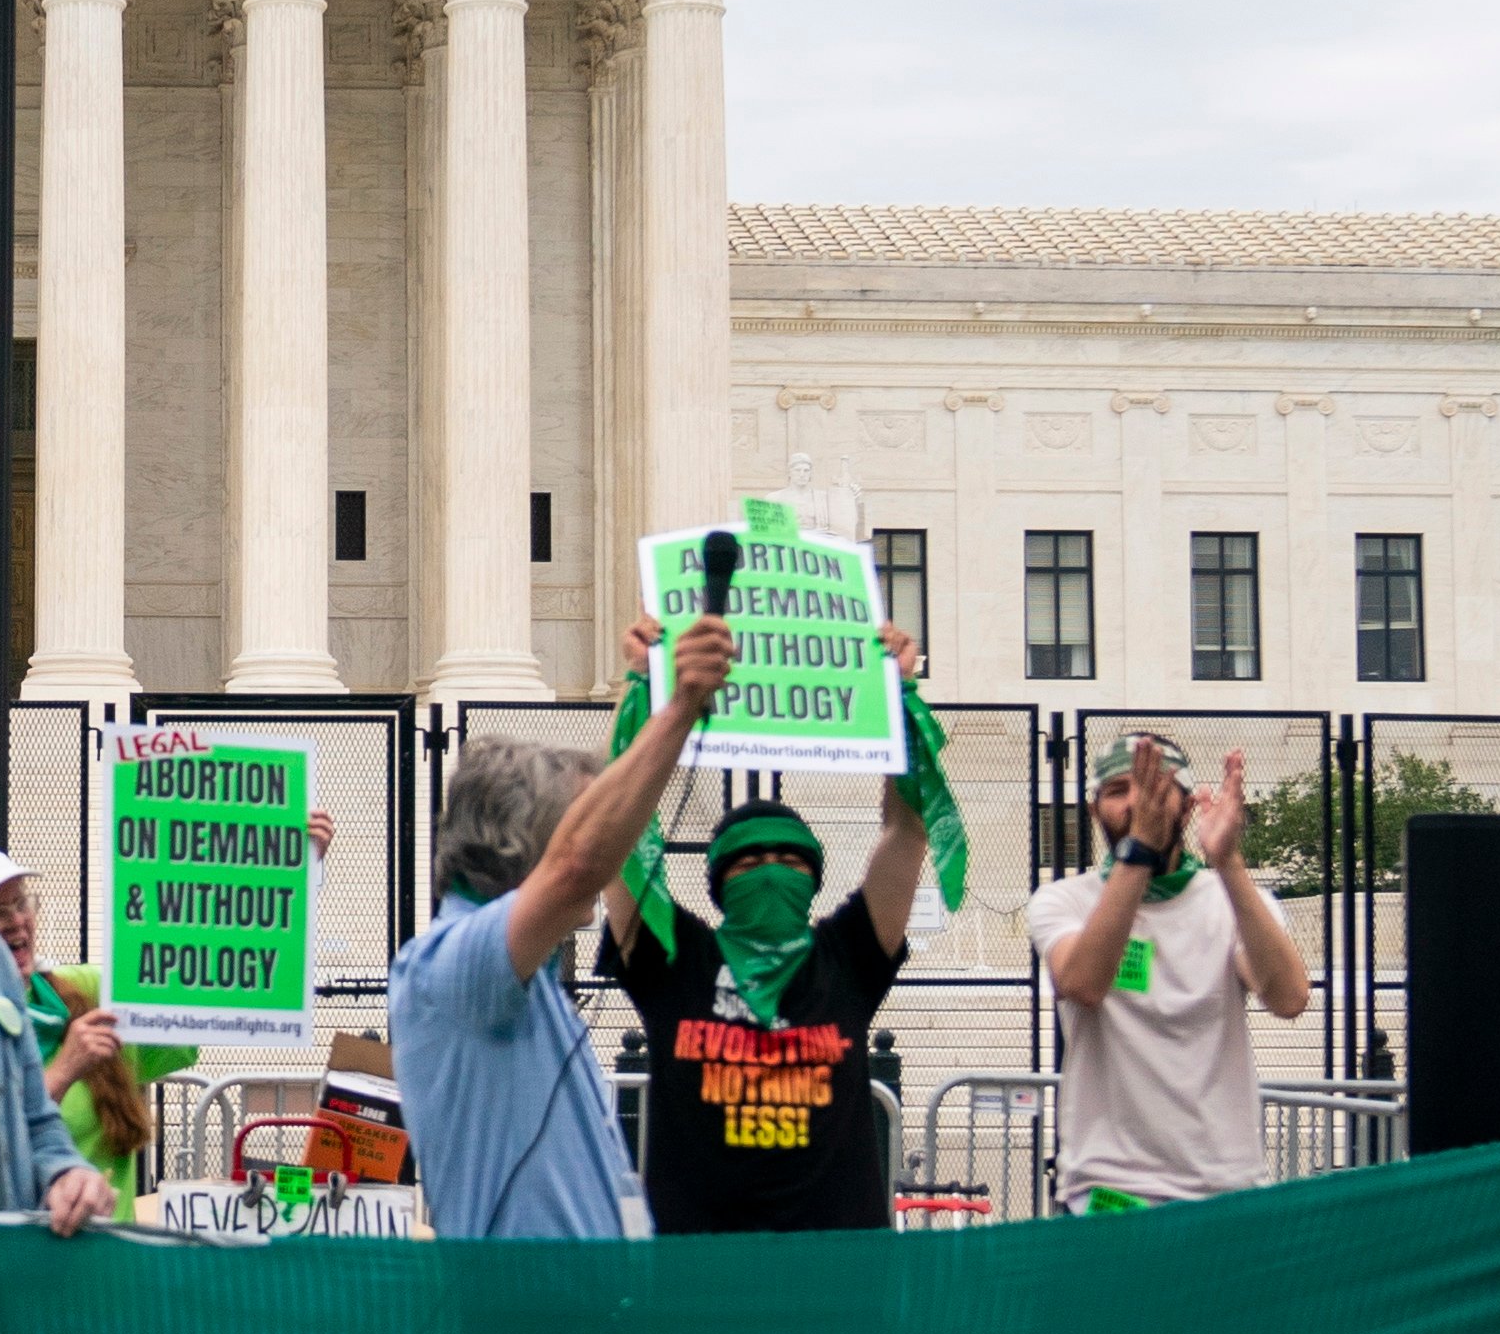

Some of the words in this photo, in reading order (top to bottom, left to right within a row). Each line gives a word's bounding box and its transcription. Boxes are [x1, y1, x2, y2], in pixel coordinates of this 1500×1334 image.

[727, 586, 869, 624] DEMAND
[117, 731, 209, 761] LEGAL
[136, 759, 287, 807] ABORTION
[118, 815, 157, 860] ON
[170, 820, 304, 869] DEMAND
[126, 883, 145, 922] &
[157, 880, 294, 930] WITHOUT
[138, 942, 278, 991] APOLOGY
[700, 1063, 833, 1107] NOTHING
[724, 1104, 811, 1148] LESS!
